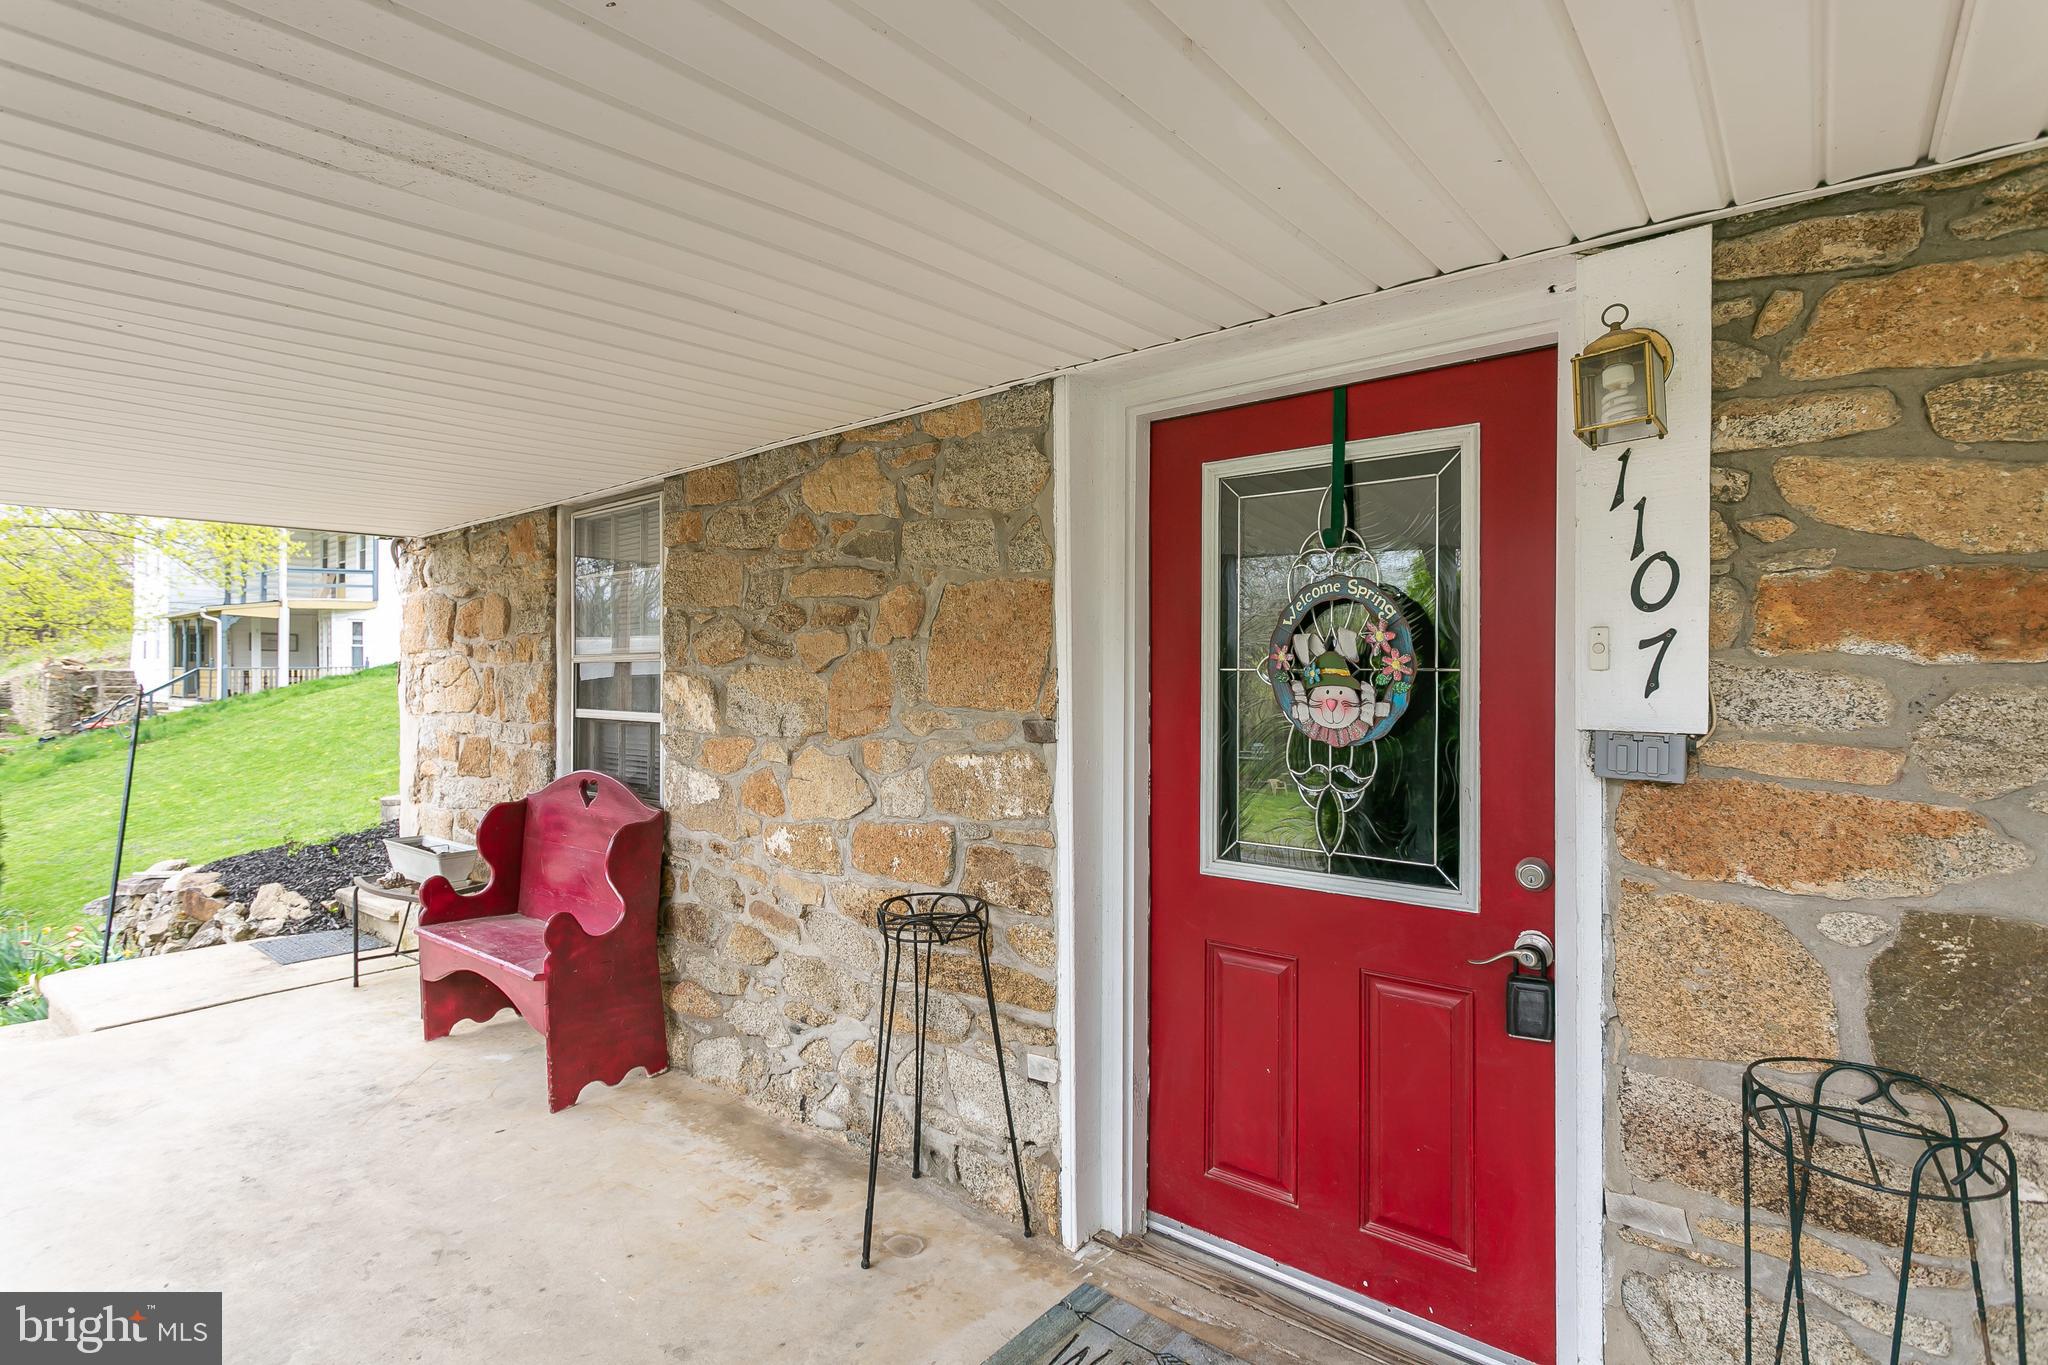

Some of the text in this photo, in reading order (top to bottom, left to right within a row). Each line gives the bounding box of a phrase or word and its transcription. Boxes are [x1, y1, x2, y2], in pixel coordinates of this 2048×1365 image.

[1283, 579, 1397, 625] Welcome Spring
[1609, 447, 1680, 699] 1107
